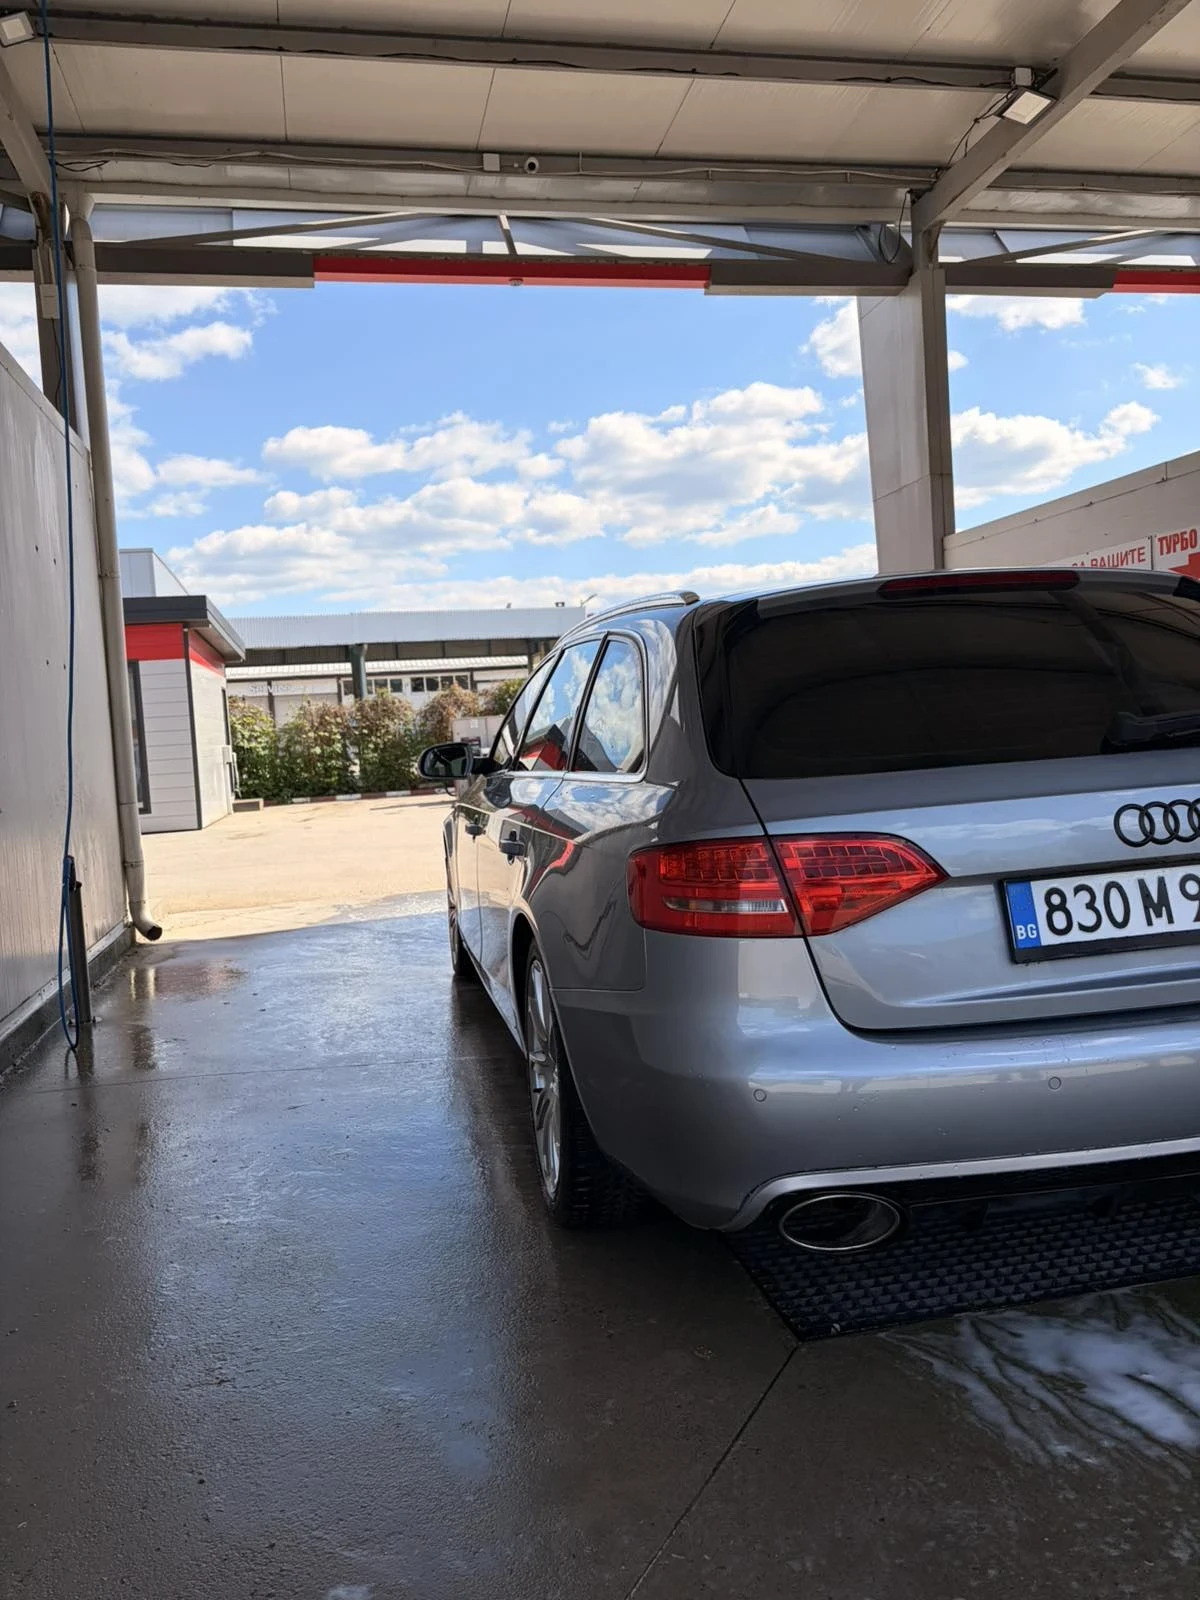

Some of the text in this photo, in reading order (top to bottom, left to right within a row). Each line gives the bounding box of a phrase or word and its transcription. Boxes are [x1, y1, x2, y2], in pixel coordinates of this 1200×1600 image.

[1157, 529, 1198, 556] ТУРБО
[1090, 546, 1146, 568] ВАШИТЕ
[1015, 923, 1037, 940] BG
